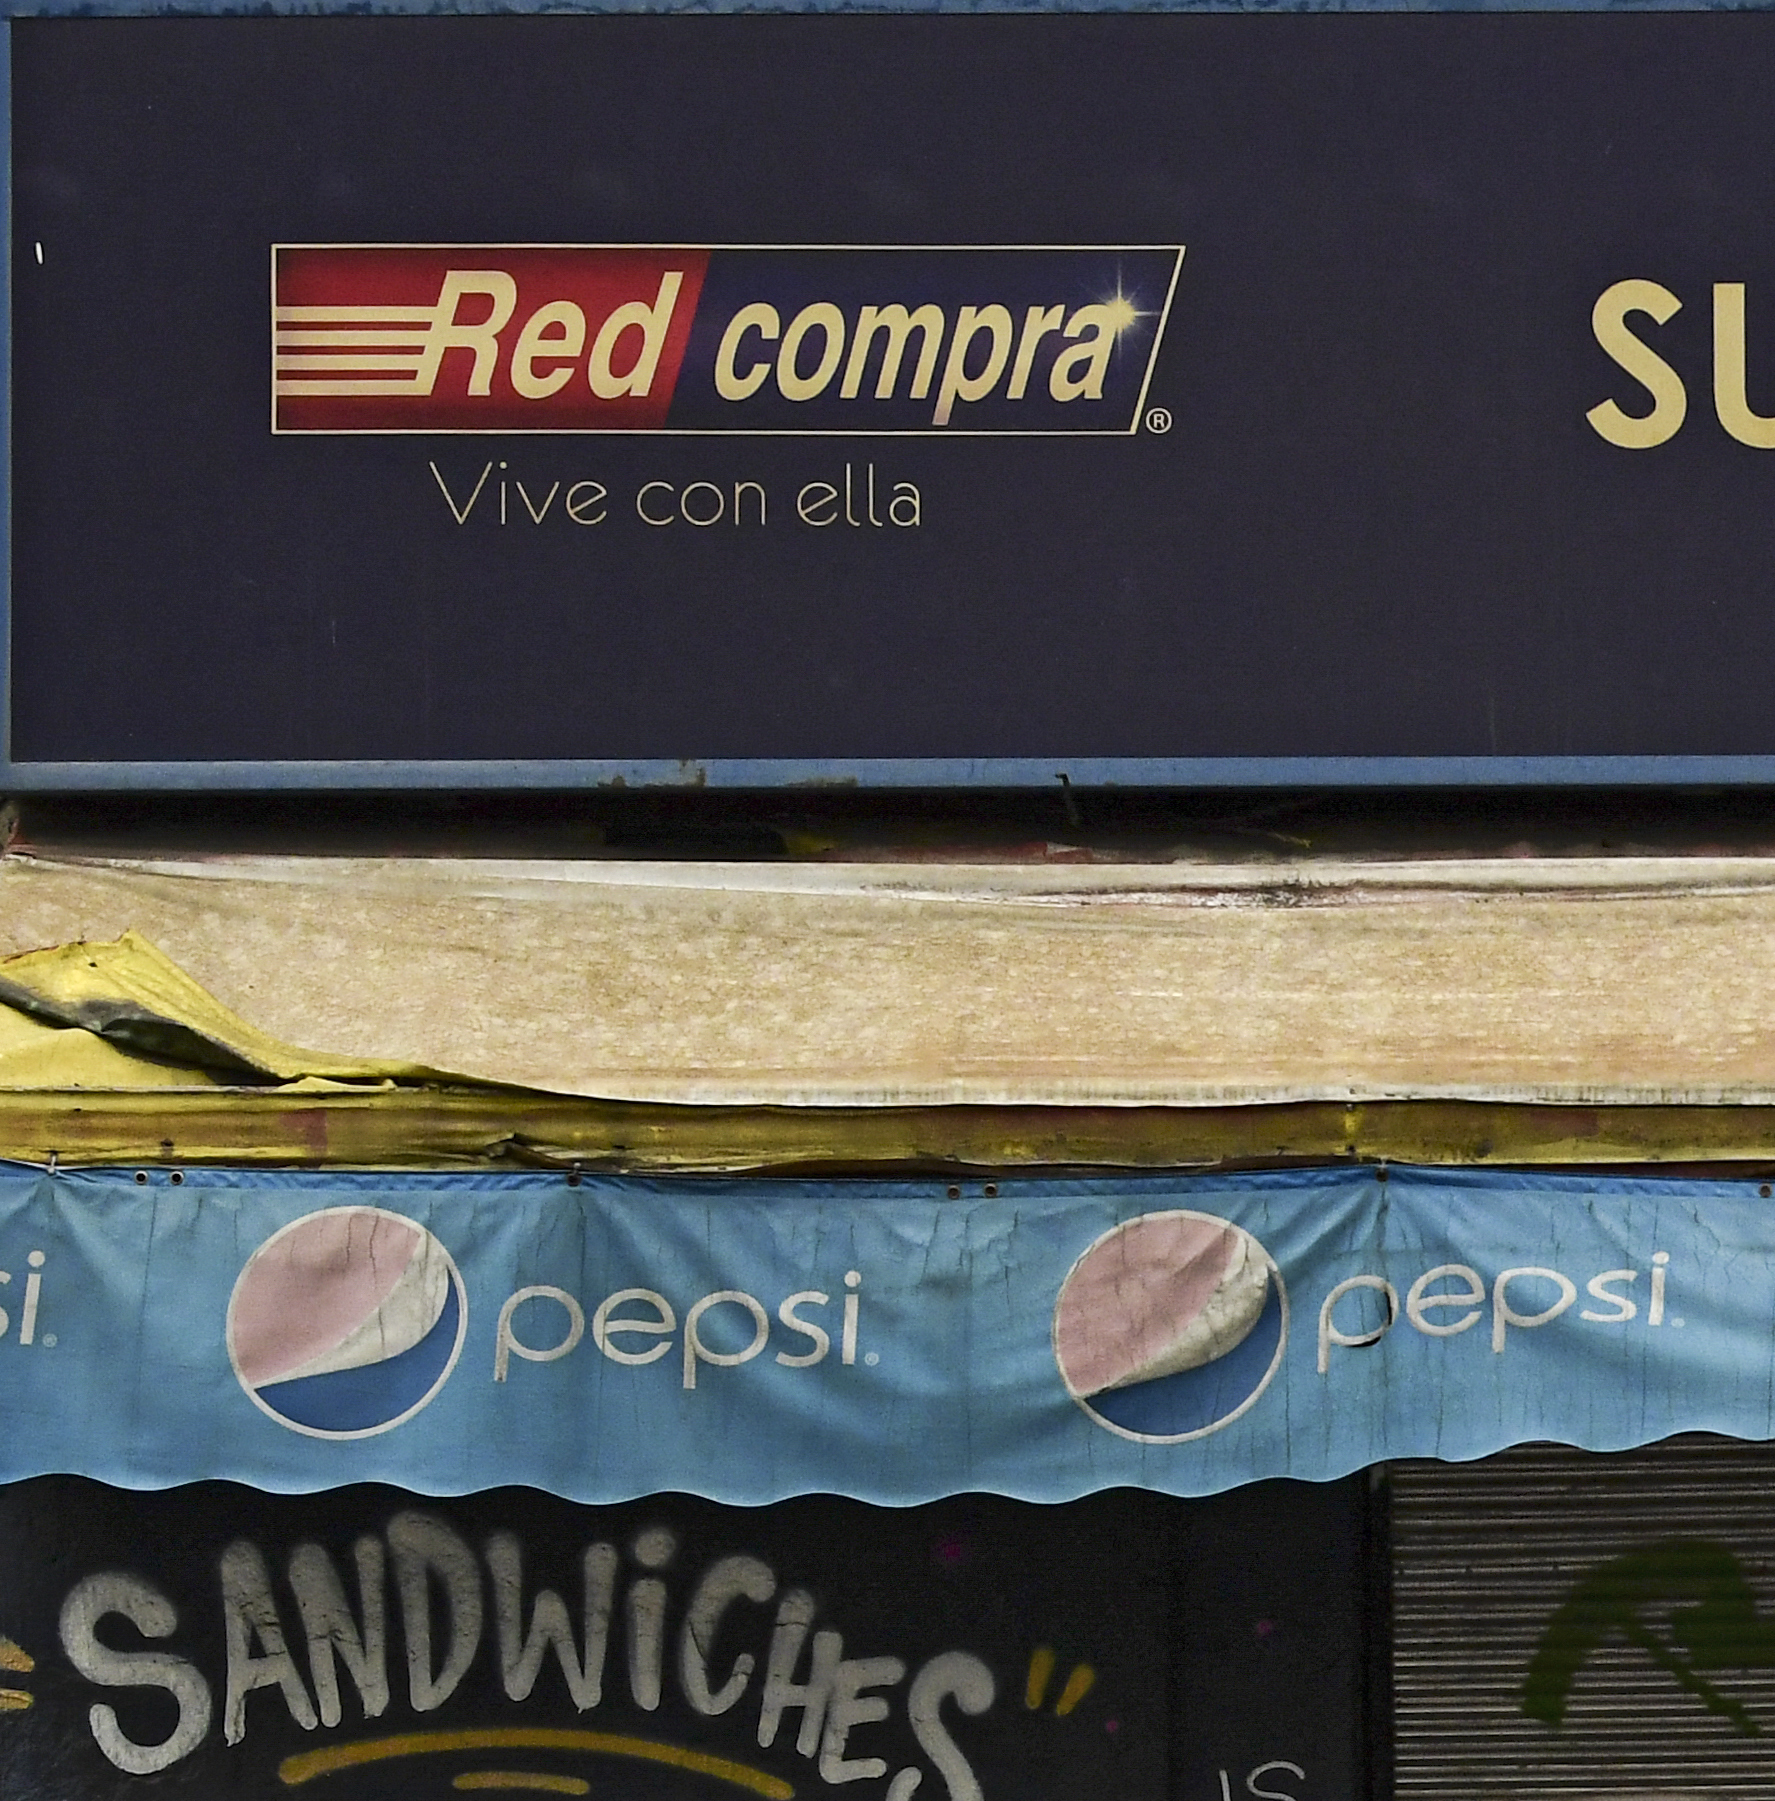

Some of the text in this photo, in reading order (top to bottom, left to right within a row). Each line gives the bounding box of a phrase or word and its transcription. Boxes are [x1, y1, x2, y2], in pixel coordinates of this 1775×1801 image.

[414, 268, 1128, 427] Red compra
[429, 461, 922, 527] Vive con ella
[493, 1270, 861, 1390] pepsi
[1317, 1251, 1671, 1375] pepsi
